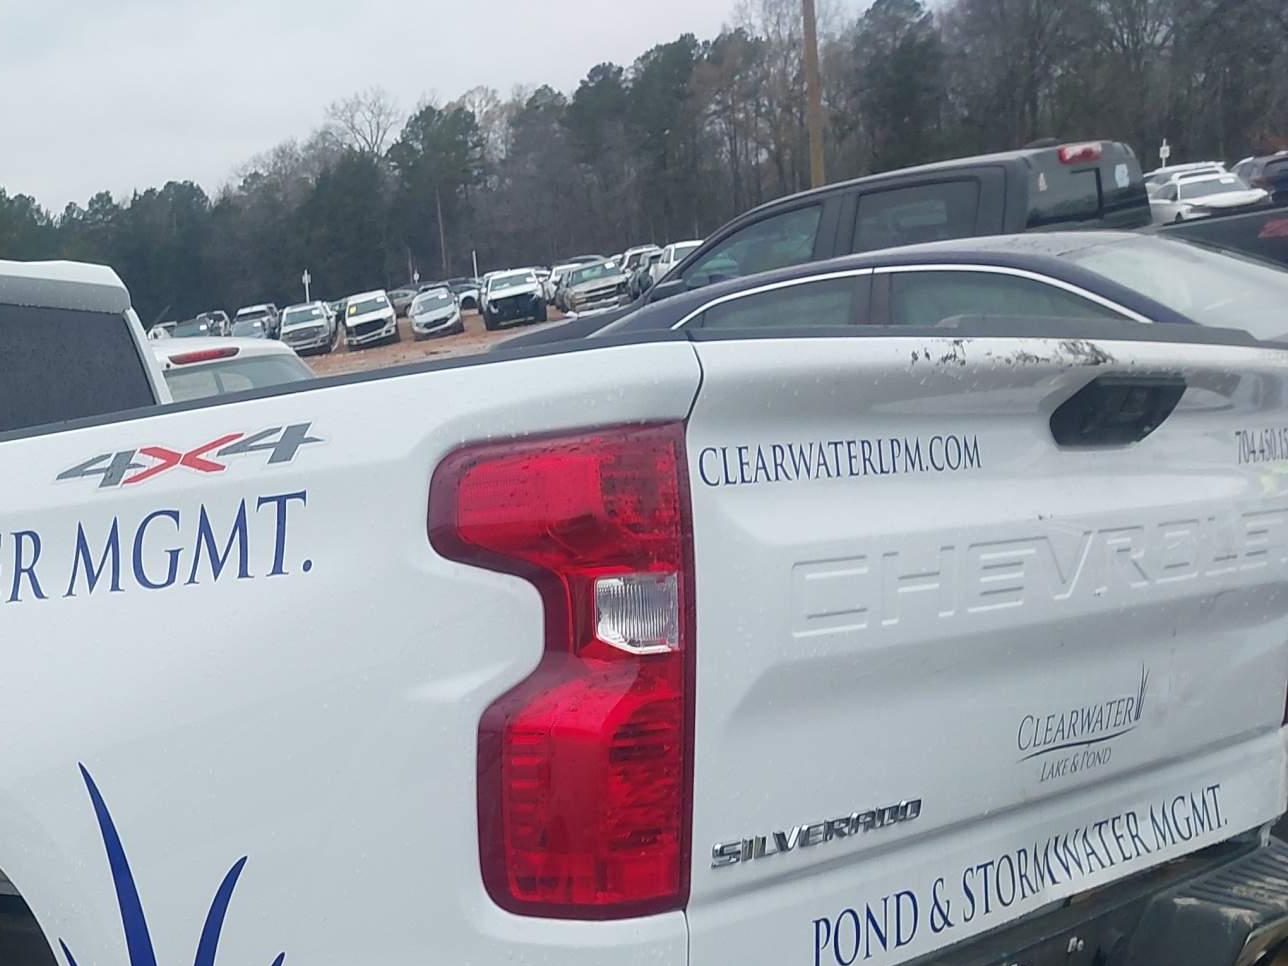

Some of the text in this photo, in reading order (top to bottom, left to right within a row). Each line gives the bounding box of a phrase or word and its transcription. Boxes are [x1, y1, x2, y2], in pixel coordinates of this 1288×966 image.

[697, 434, 983, 487] CLEARWATERLPM.COM
[62, 489, 314, 600] MGMT.
[792, 507, 1288, 639] CHEVROLE
[1017, 696, 1135, 751] CLEARWATER
[1040, 747, 1112, 783] LAKE & POND
[711, 798, 922, 869] SILVERADO
[929, 877, 955, 934] &
[961, 811, 1152, 924] STORMWATER
[1149, 783, 1229, 851] MGMT.
